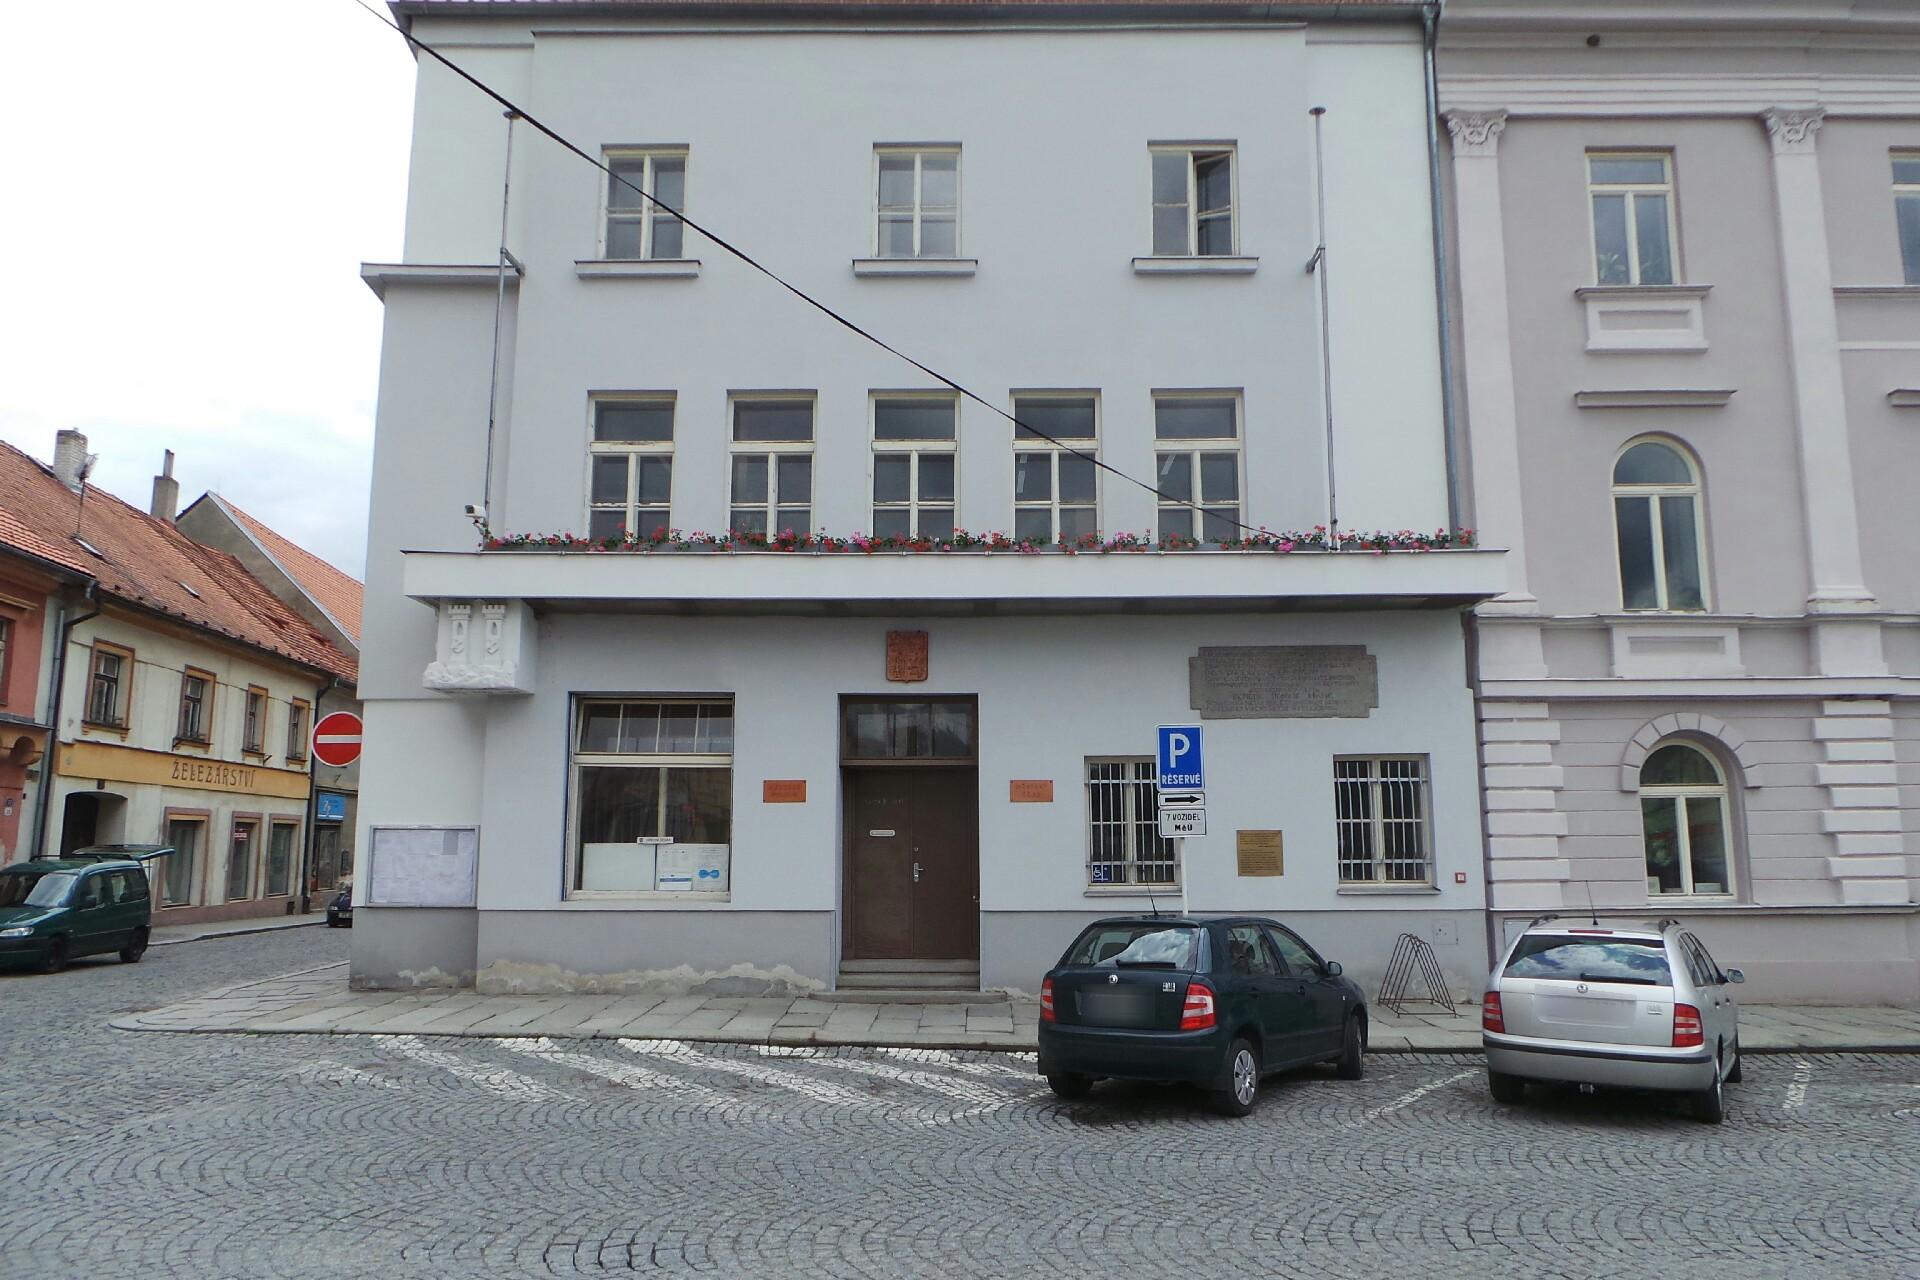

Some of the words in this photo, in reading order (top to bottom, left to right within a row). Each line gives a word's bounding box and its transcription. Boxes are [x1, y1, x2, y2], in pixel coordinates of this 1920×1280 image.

[1169, 733, 1190, 768] P
[1166, 813, 1171, 821] 7
[1172, 813, 1201, 821] VOZIDEL
